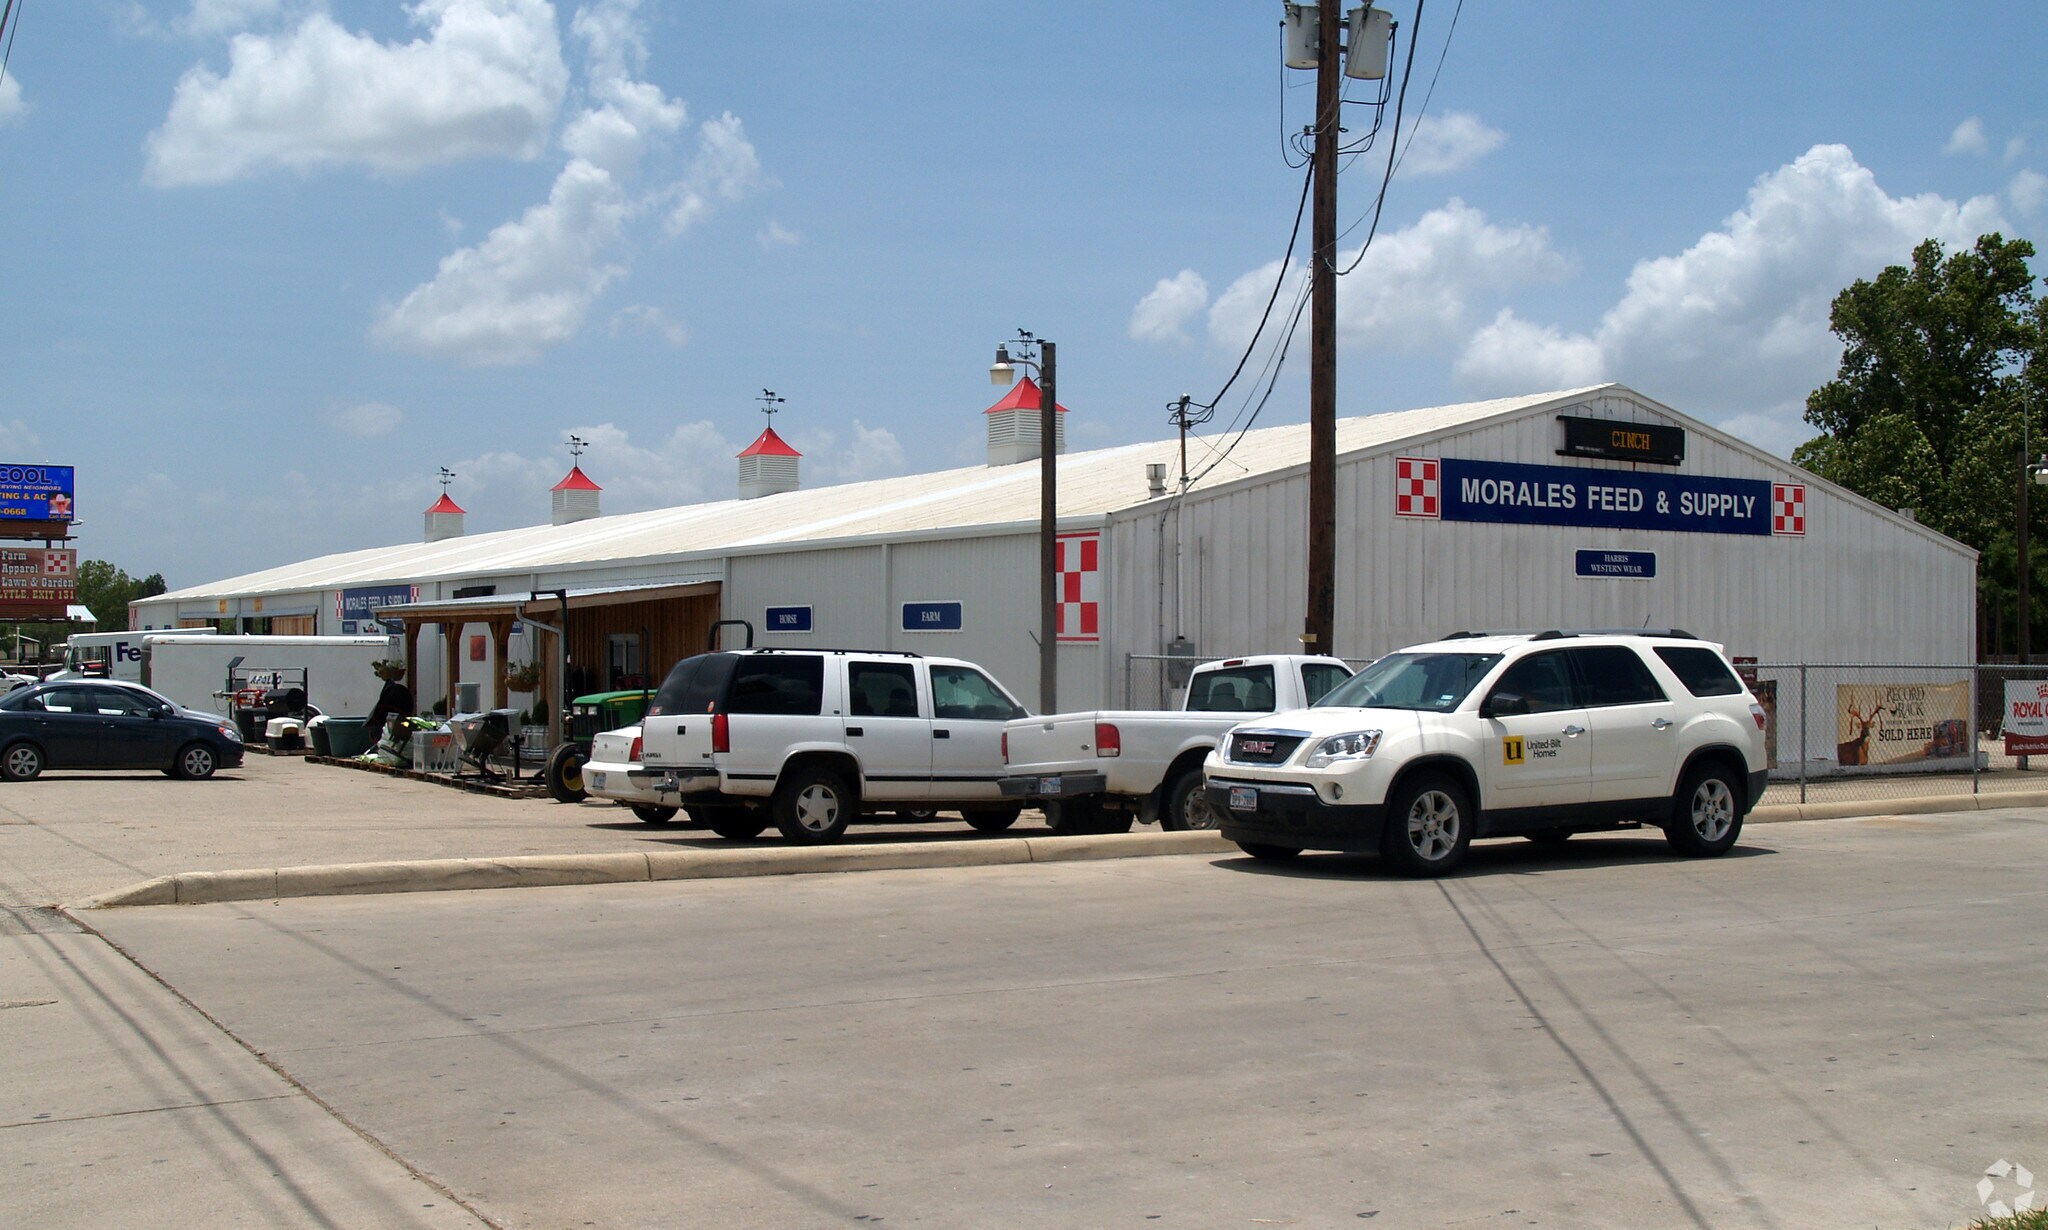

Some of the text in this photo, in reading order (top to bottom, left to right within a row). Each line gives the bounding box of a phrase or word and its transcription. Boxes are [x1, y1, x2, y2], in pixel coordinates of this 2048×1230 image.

[1611, 430, 1651, 450] CINCH
[33, 493, 47, 501] AC
[1461, 477, 1756, 518] MORALES FEED & SUPPLY
[1, 550, 27, 560] Farm
[1604, 554, 1630, 563] HARRIS
[1, 563, 39, 575] Apparel
[1590, 563, 1643, 574] WESTERN WEAR
[1, 577, 74, 588] Lawn & Garden
[32, 590, 55, 600] EXIT
[779, 614, 798, 624] HORSE
[921, 611, 941, 622] FARM
[250, 675, 283, 685] APOLO
[1886, 687, 1925, 703] RECORD
[2013, 701, 2043, 718] ROYAL
[1879, 727, 1932, 742] SOLD HERE
[1242, 740, 1275, 754] GMC
[1526, 739, 1562, 750] United-Bilt
[1533, 749, 1558, 759] Homes
